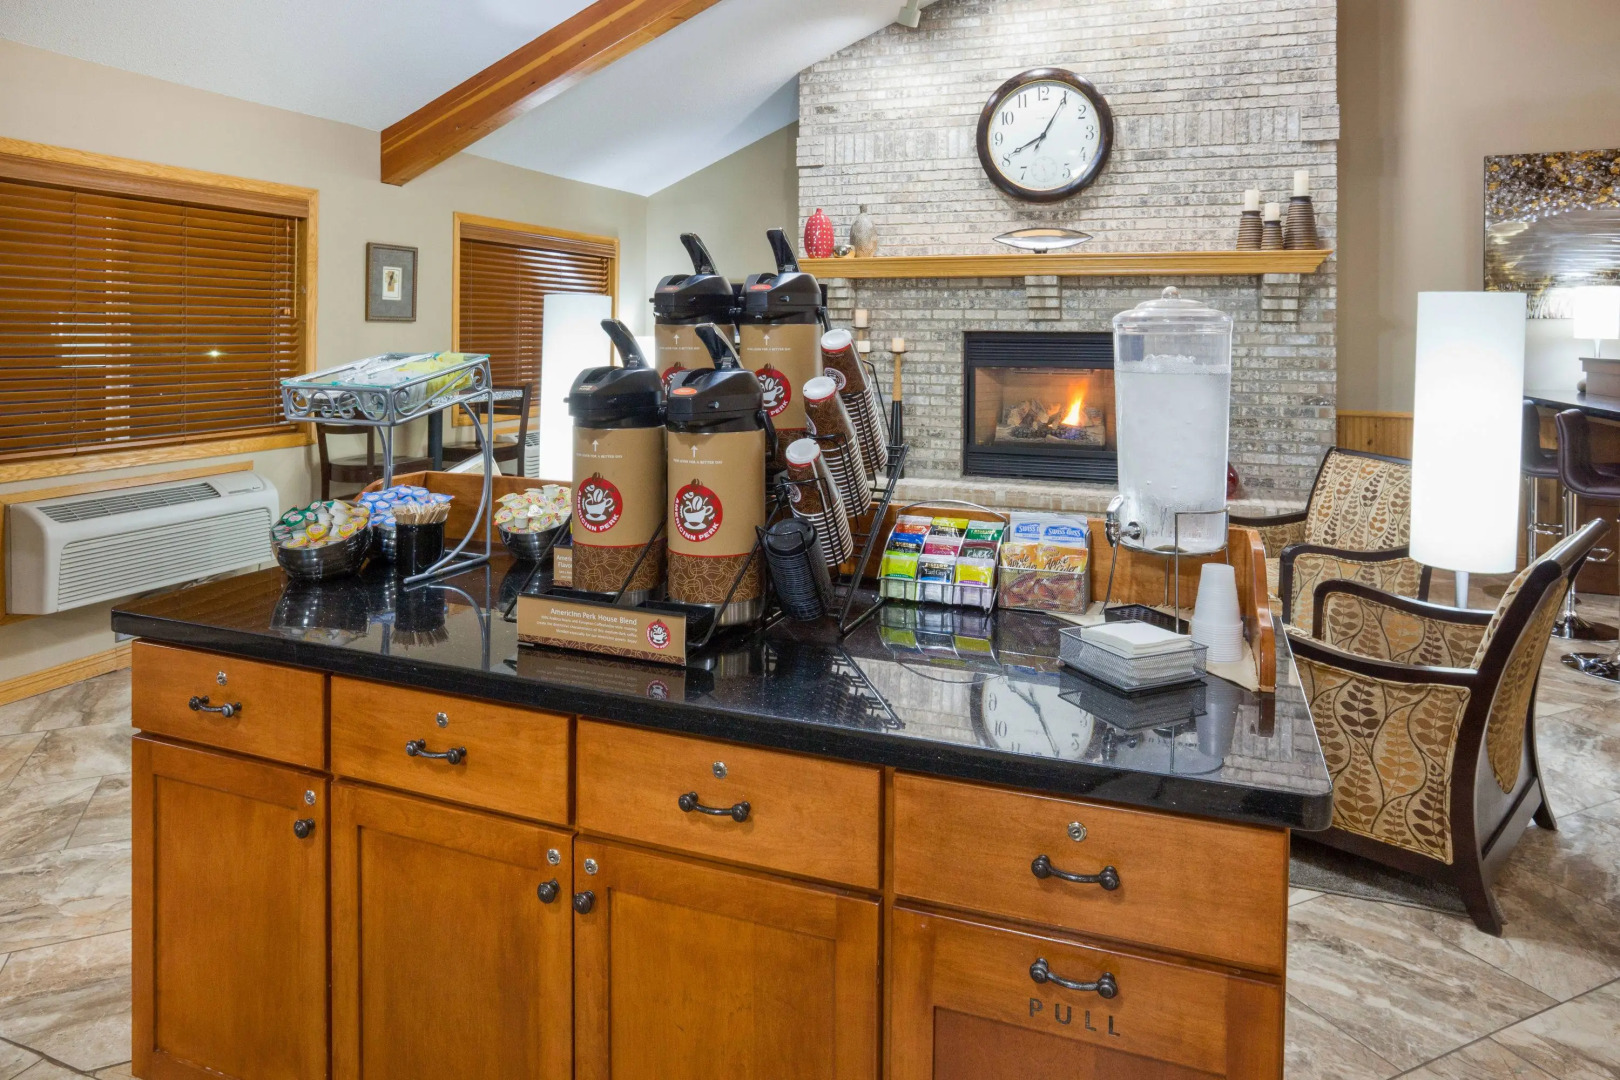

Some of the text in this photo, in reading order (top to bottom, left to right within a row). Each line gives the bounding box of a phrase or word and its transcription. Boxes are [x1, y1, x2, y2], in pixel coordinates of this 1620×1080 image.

[1018, 93, 1027, 108] 11
[1038, 86, 1050, 102] 12
[1001, 111, 1014, 126] 10
[1077, 104, 1087, 120] 2
[994, 131, 1004, 146] 9
[1085, 124, 1095, 141] 3
[1001, 152, 1011, 168] 8
[1078, 146, 1087, 162] 4
[1020, 165, 1027, 180] 7
[1062, 162, 1071, 179] 5
[770, 400, 788, 416] PERK
[599, 514, 620, 531] PERK
[698, 522, 719, 541] PERK
[550, 608, 582, 618] AmericInn
[582, 612, 596, 620] Perk
[598, 614, 618, 623] House
[619, 616, 638, 626] Blend
[1029, 997, 1121, 1037] PULL
